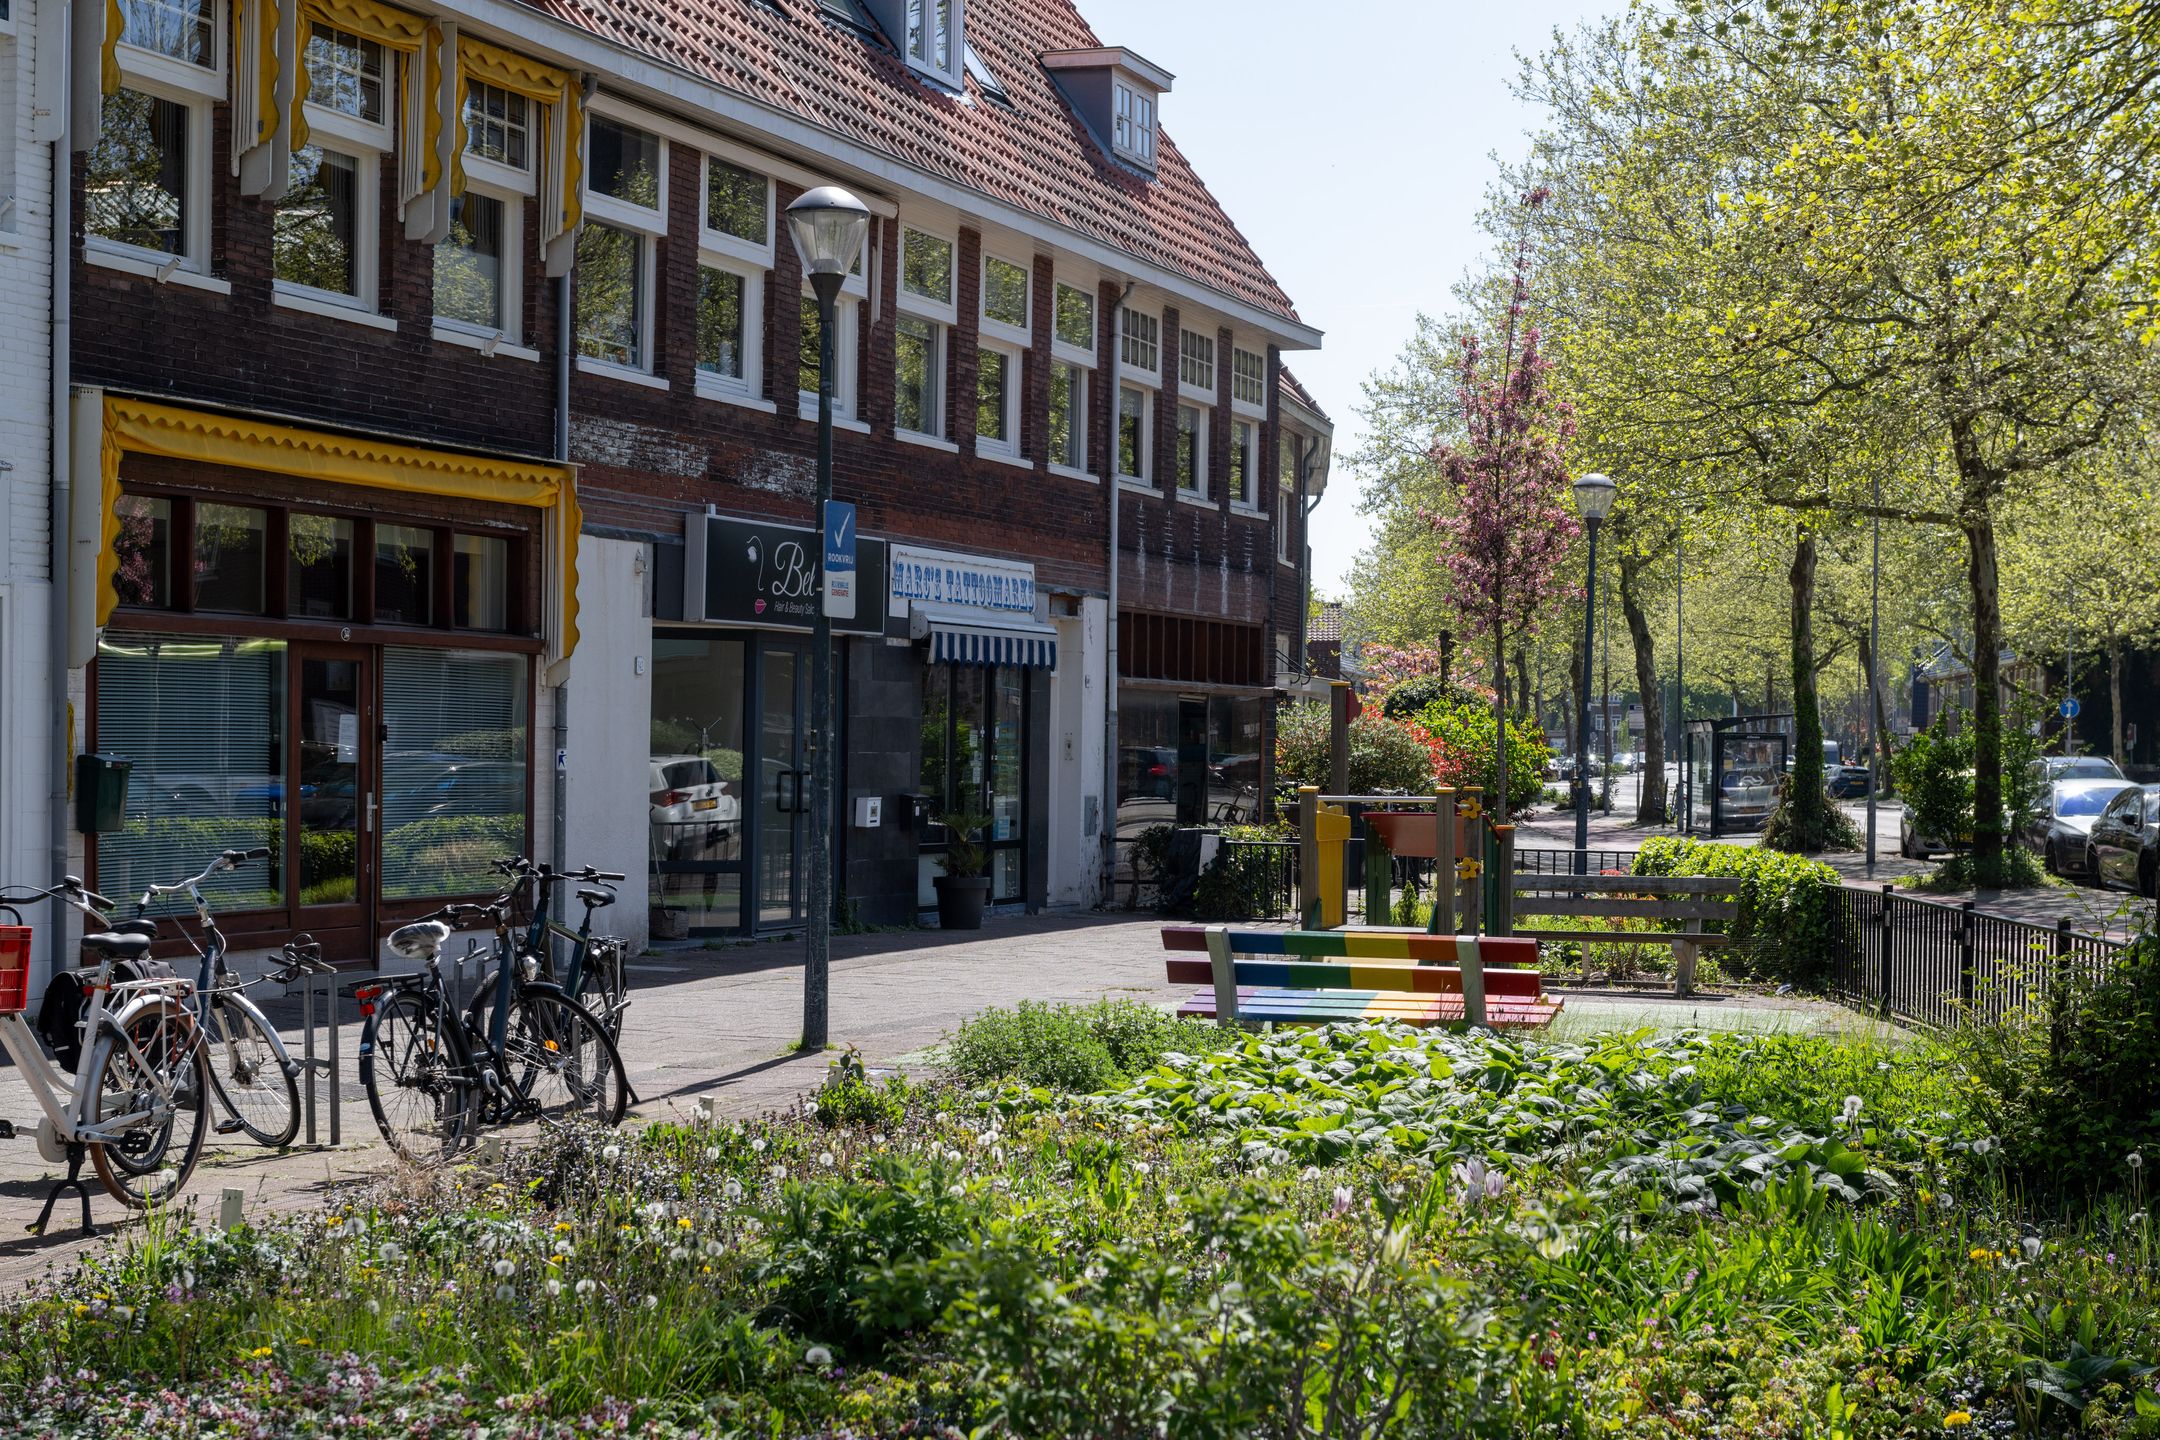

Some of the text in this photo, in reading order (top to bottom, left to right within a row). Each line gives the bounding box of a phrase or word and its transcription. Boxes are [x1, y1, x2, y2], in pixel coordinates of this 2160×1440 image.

[772, 542, 816, 597] Bel
[828, 552, 853, 565] ROOKVRIJ
[893, 561, 1034, 611] MARC'S TATTOOMARKS
[774, 601, 785, 612] Hair
[789, 602, 805, 616] Beauty
